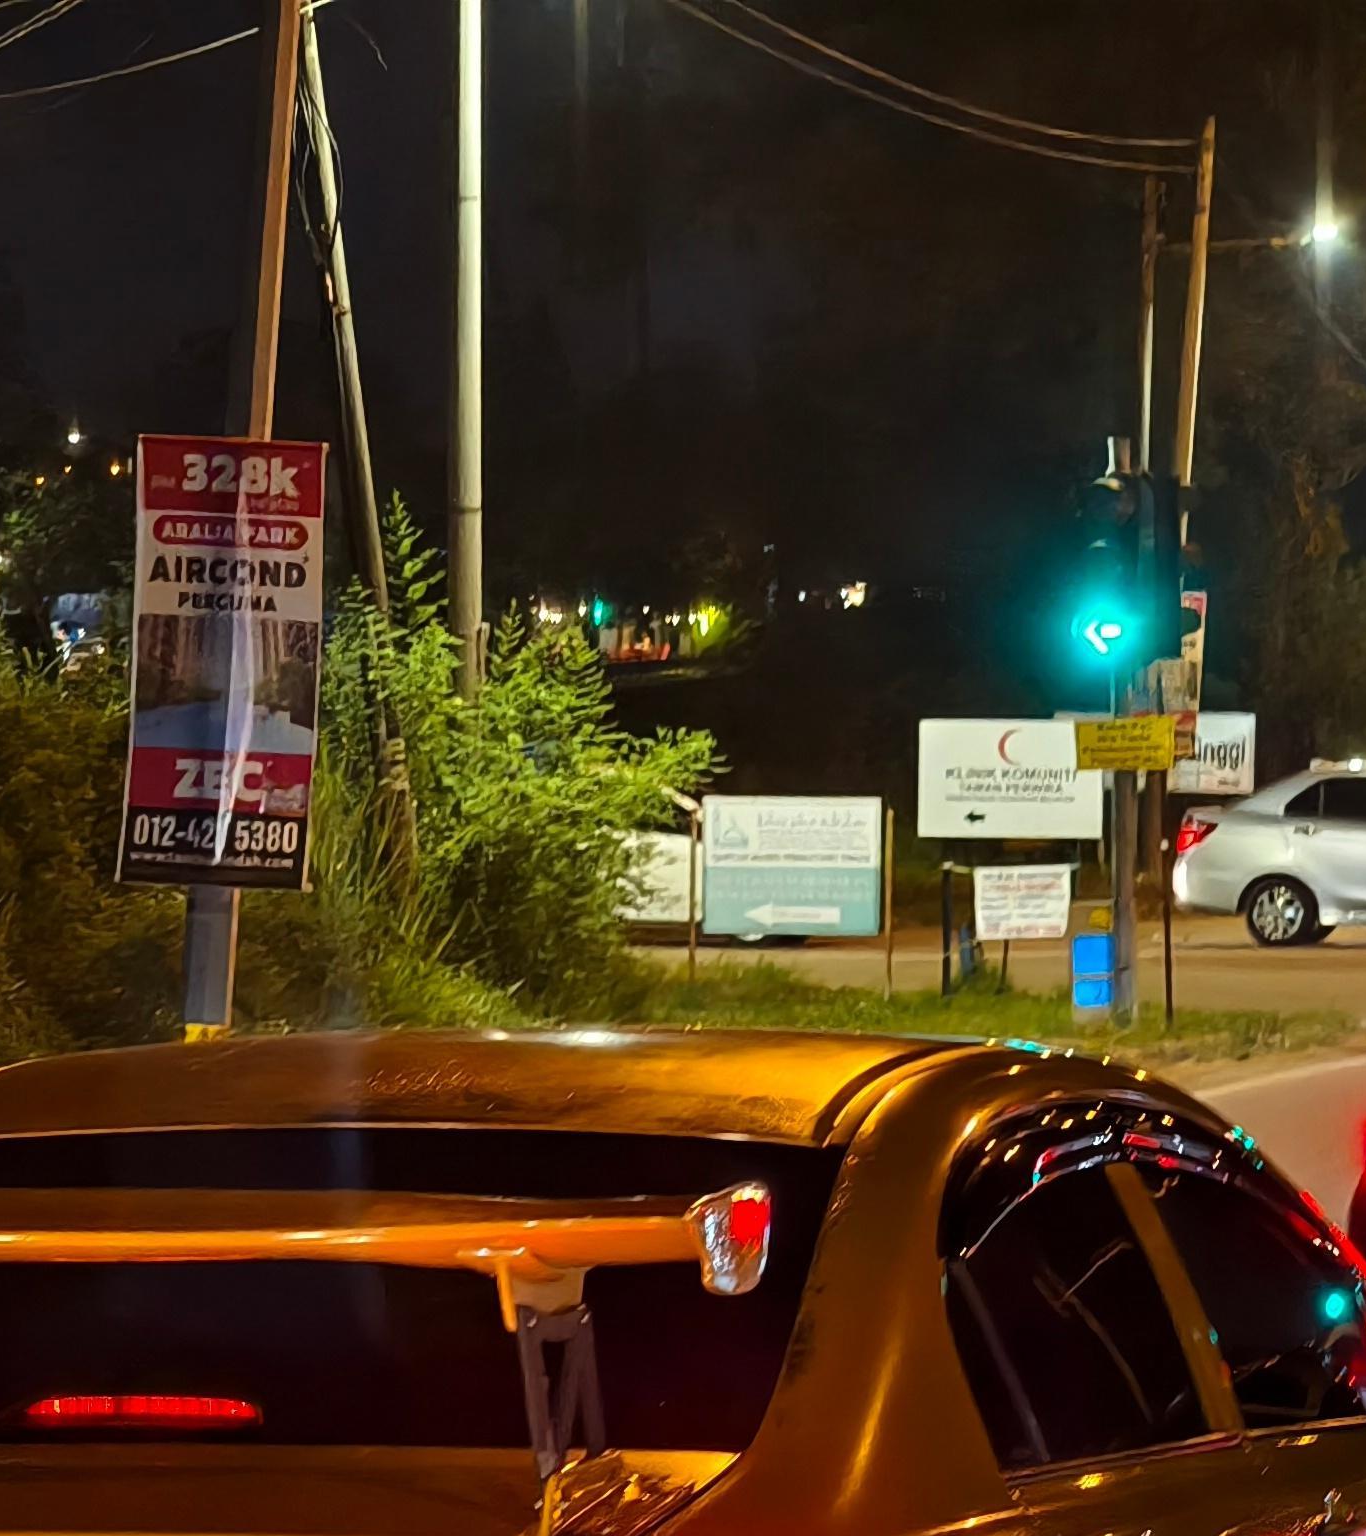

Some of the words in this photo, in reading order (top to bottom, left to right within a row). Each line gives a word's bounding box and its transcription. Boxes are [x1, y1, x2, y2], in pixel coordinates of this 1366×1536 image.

[181, 453, 301, 499] 328k
[148, 555, 307, 588] AIRCOND
[133, 813, 298, 854] 012-425380
